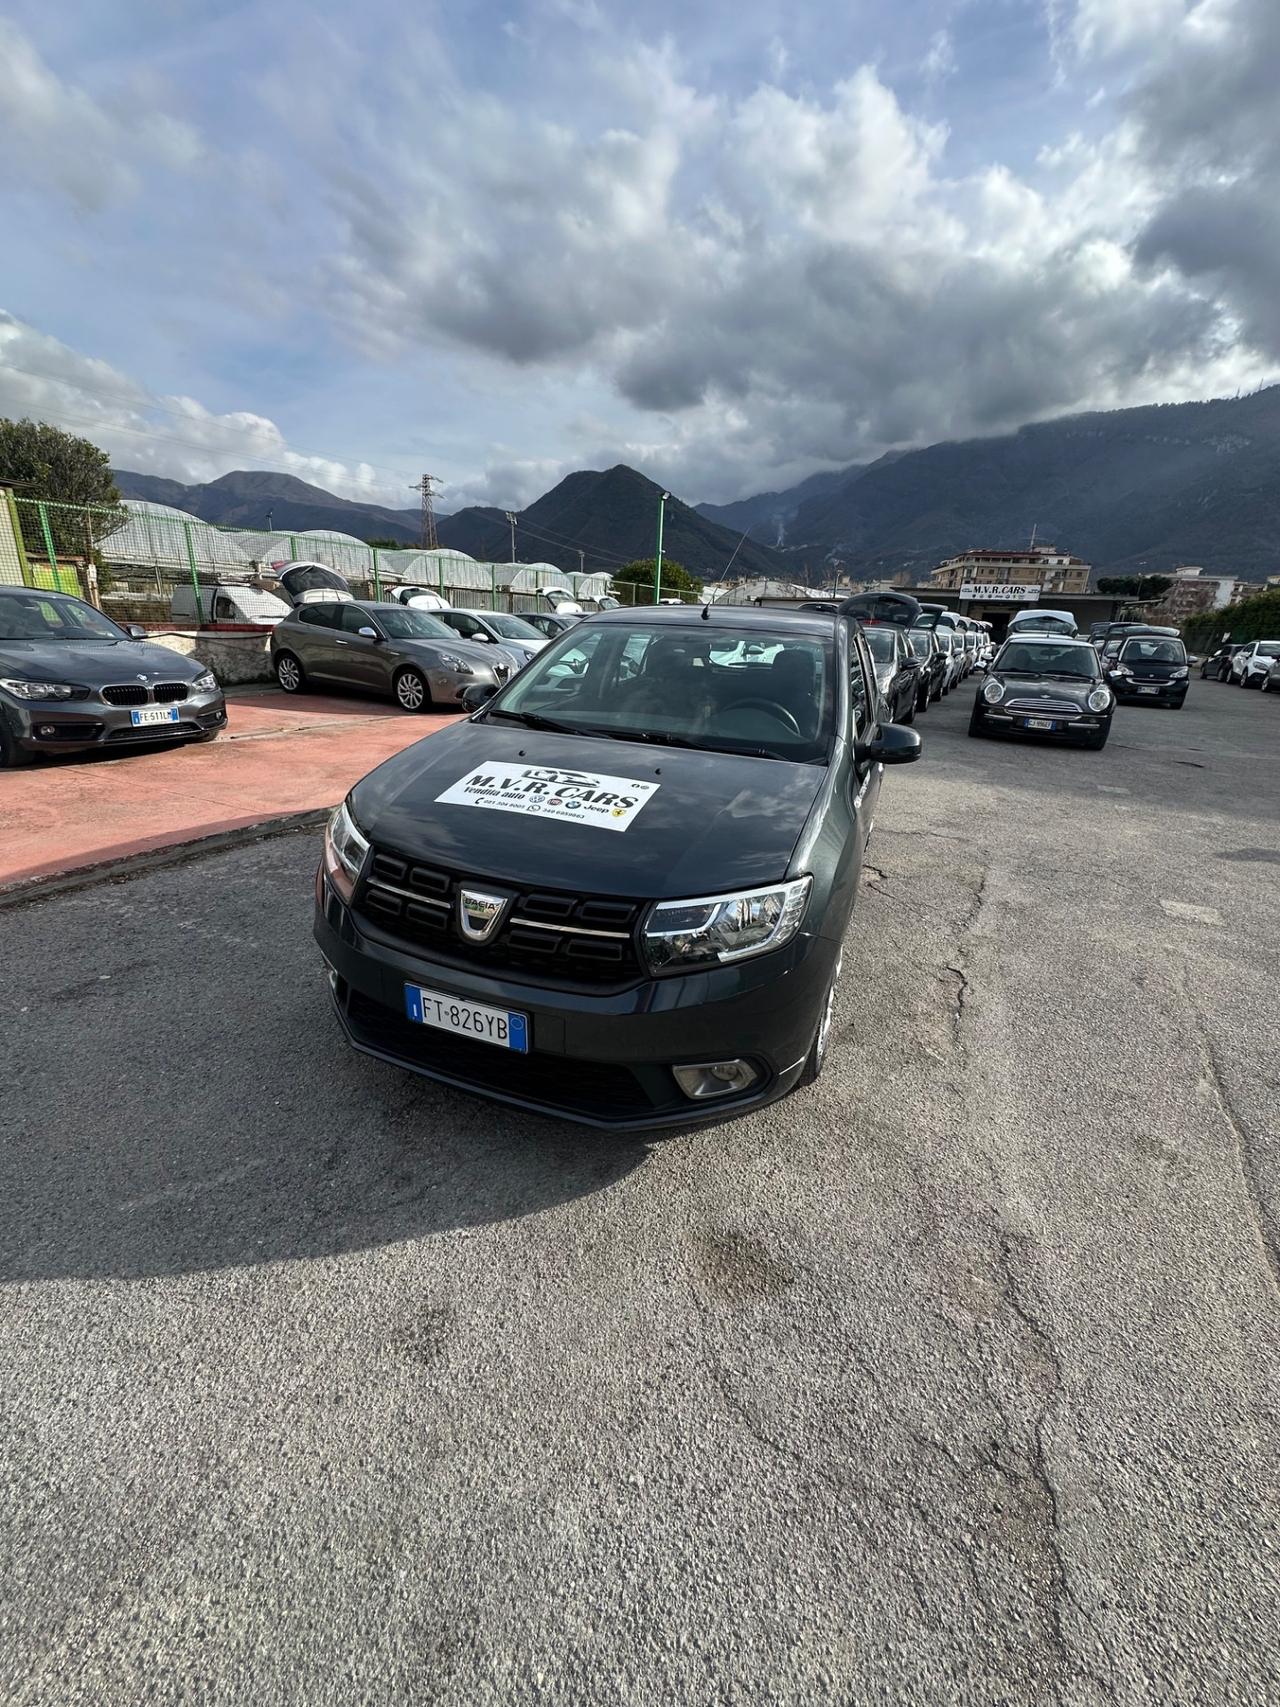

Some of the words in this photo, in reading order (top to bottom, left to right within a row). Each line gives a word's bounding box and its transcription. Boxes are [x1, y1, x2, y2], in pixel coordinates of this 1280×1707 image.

[463, 786, 501, 799] Vendita
[501, 791, 526, 800] auto
[554, 786, 639, 809] CARS
[584, 804, 610, 814] Jeep
[465, 898, 496, 910] DACIA
